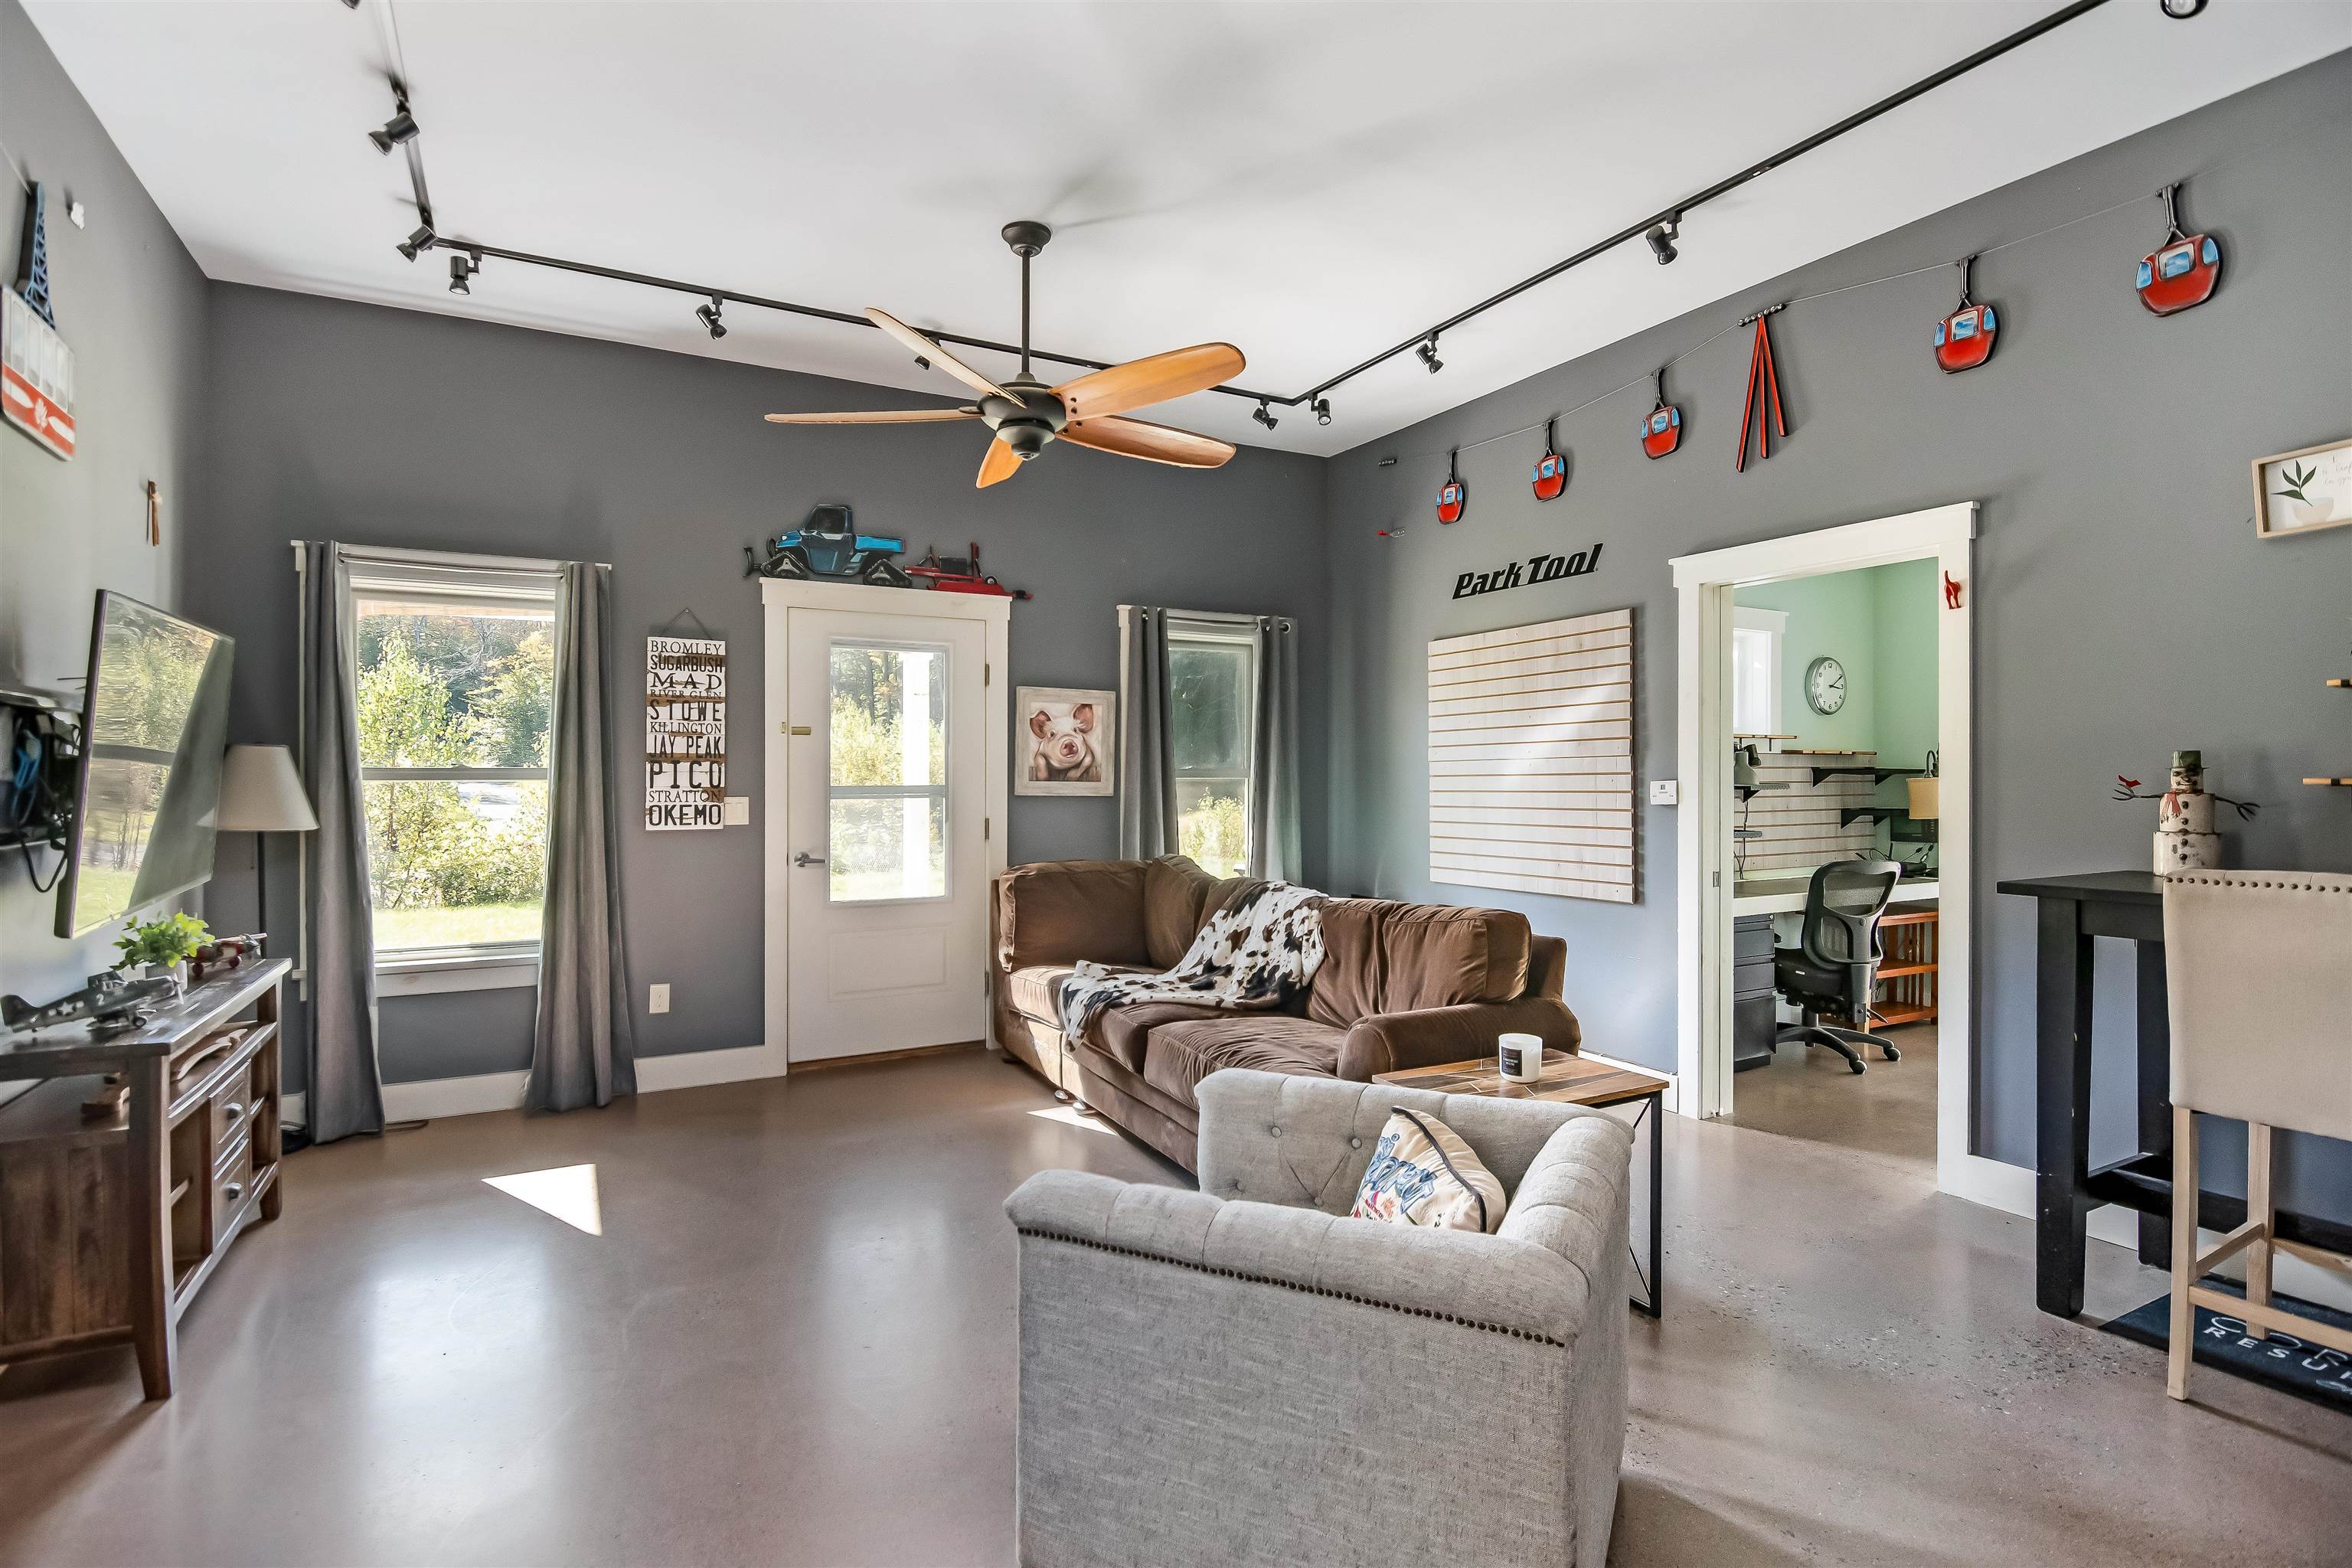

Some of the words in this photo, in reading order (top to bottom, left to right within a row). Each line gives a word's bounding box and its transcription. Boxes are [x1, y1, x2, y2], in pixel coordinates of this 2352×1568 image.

[1452, 561, 1524, 599] Park
[1527, 542, 1604, 585] Tool
[650, 640, 723, 655] BROMLEY
[650, 654, 723, 673] SUGARBUSH
[650, 672, 722, 691] MAD
[650, 689, 685, 698] RIVER
[690, 690, 722, 700] GLEN
[649, 698, 723, 721] STOWE
[650, 721, 722, 734] KILLINGTON
[649, 735, 676, 758] JAY
[686, 736, 722, 759] PEAK
[648, 760, 722, 789] PICO
[648, 789, 723, 803] STRATTON
[648, 804, 722, 826] OKEMO
